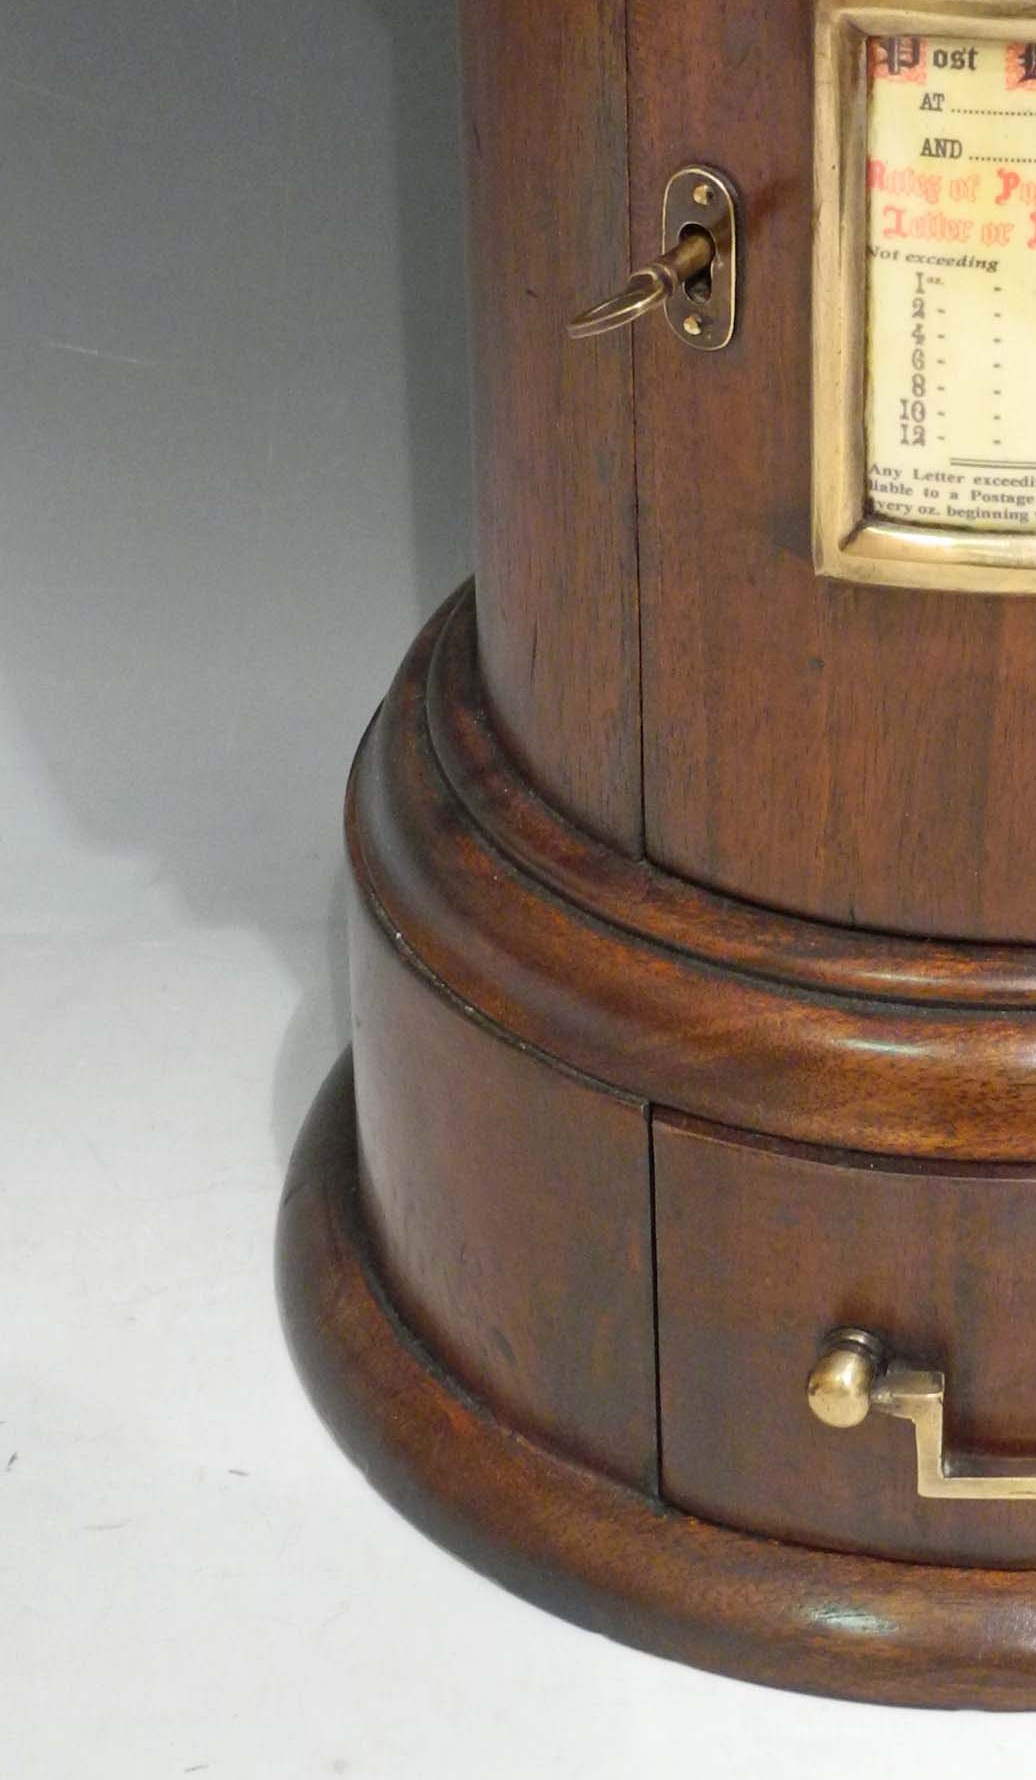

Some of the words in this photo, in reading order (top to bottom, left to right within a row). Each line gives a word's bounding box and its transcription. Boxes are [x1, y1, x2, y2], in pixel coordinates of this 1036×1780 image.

[920, 92, 945, 112] AT
[920, 138, 962, 159] AND
[905, 254, 999, 272] exceeding
[912, 297, 926, 319] 2
[911, 323, 925, 346] 4
[912, 348, 926, 371] 6
[911, 373, 926, 397] 8
[900, 398, 926, 423] 10
[900, 423, 926, 447] 12
[870, 463, 902, 481] Any
[913, 468, 965, 484] Letter
[923, 486, 939, 499] to
[950, 491, 959, 501] a
[971, 490, 1036, 506] Postage
[947, 506, 1029, 523] beginning
